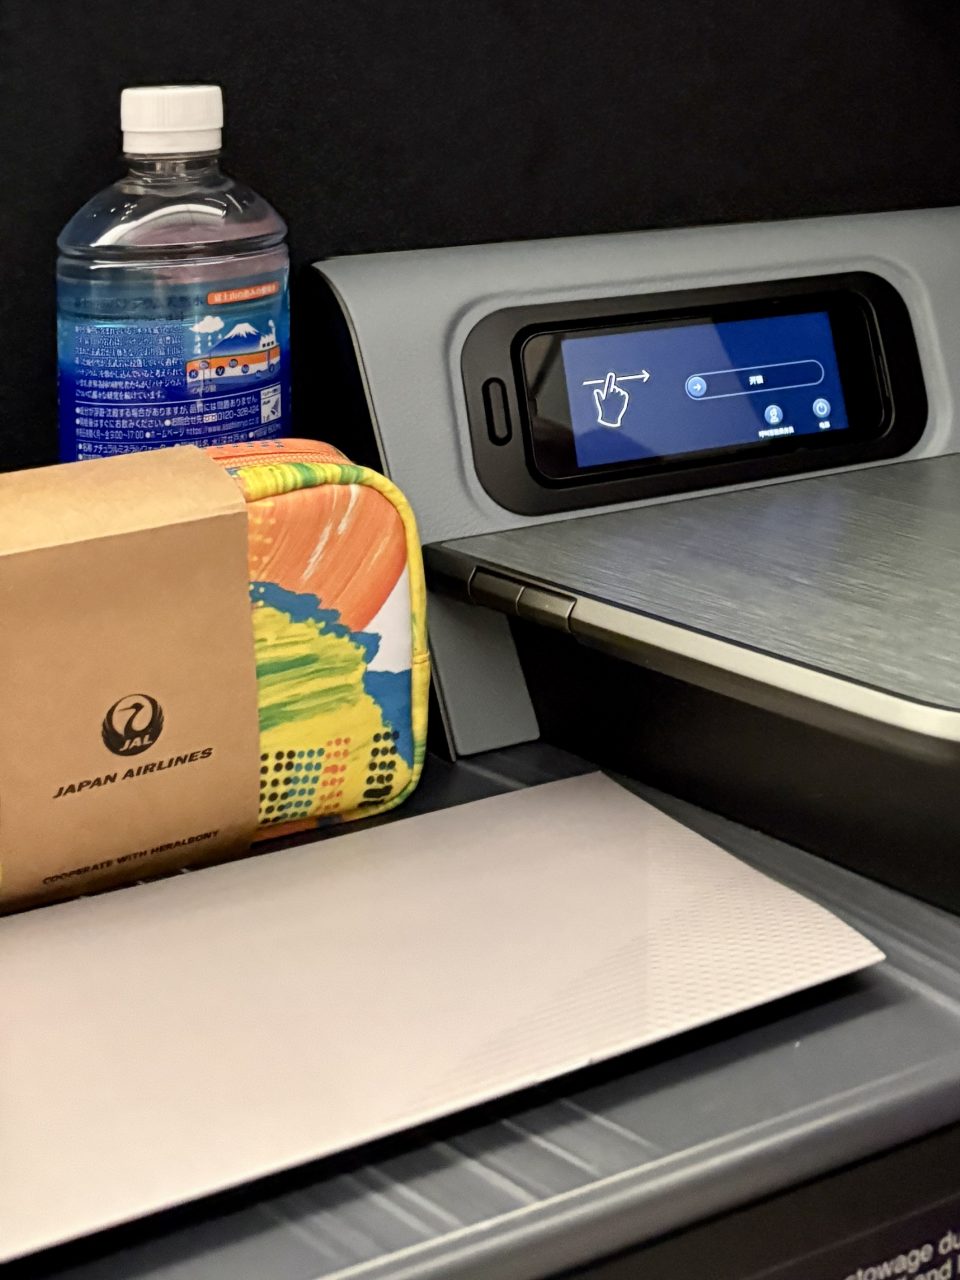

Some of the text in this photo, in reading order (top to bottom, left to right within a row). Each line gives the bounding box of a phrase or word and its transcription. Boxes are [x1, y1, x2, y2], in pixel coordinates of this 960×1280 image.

[119, 734, 153, 752] JAL
[52, 747, 214, 799] JAPAN AIRLINES
[116, 850, 148, 865] WITH
[150, 830, 219, 855] HERALBONY
